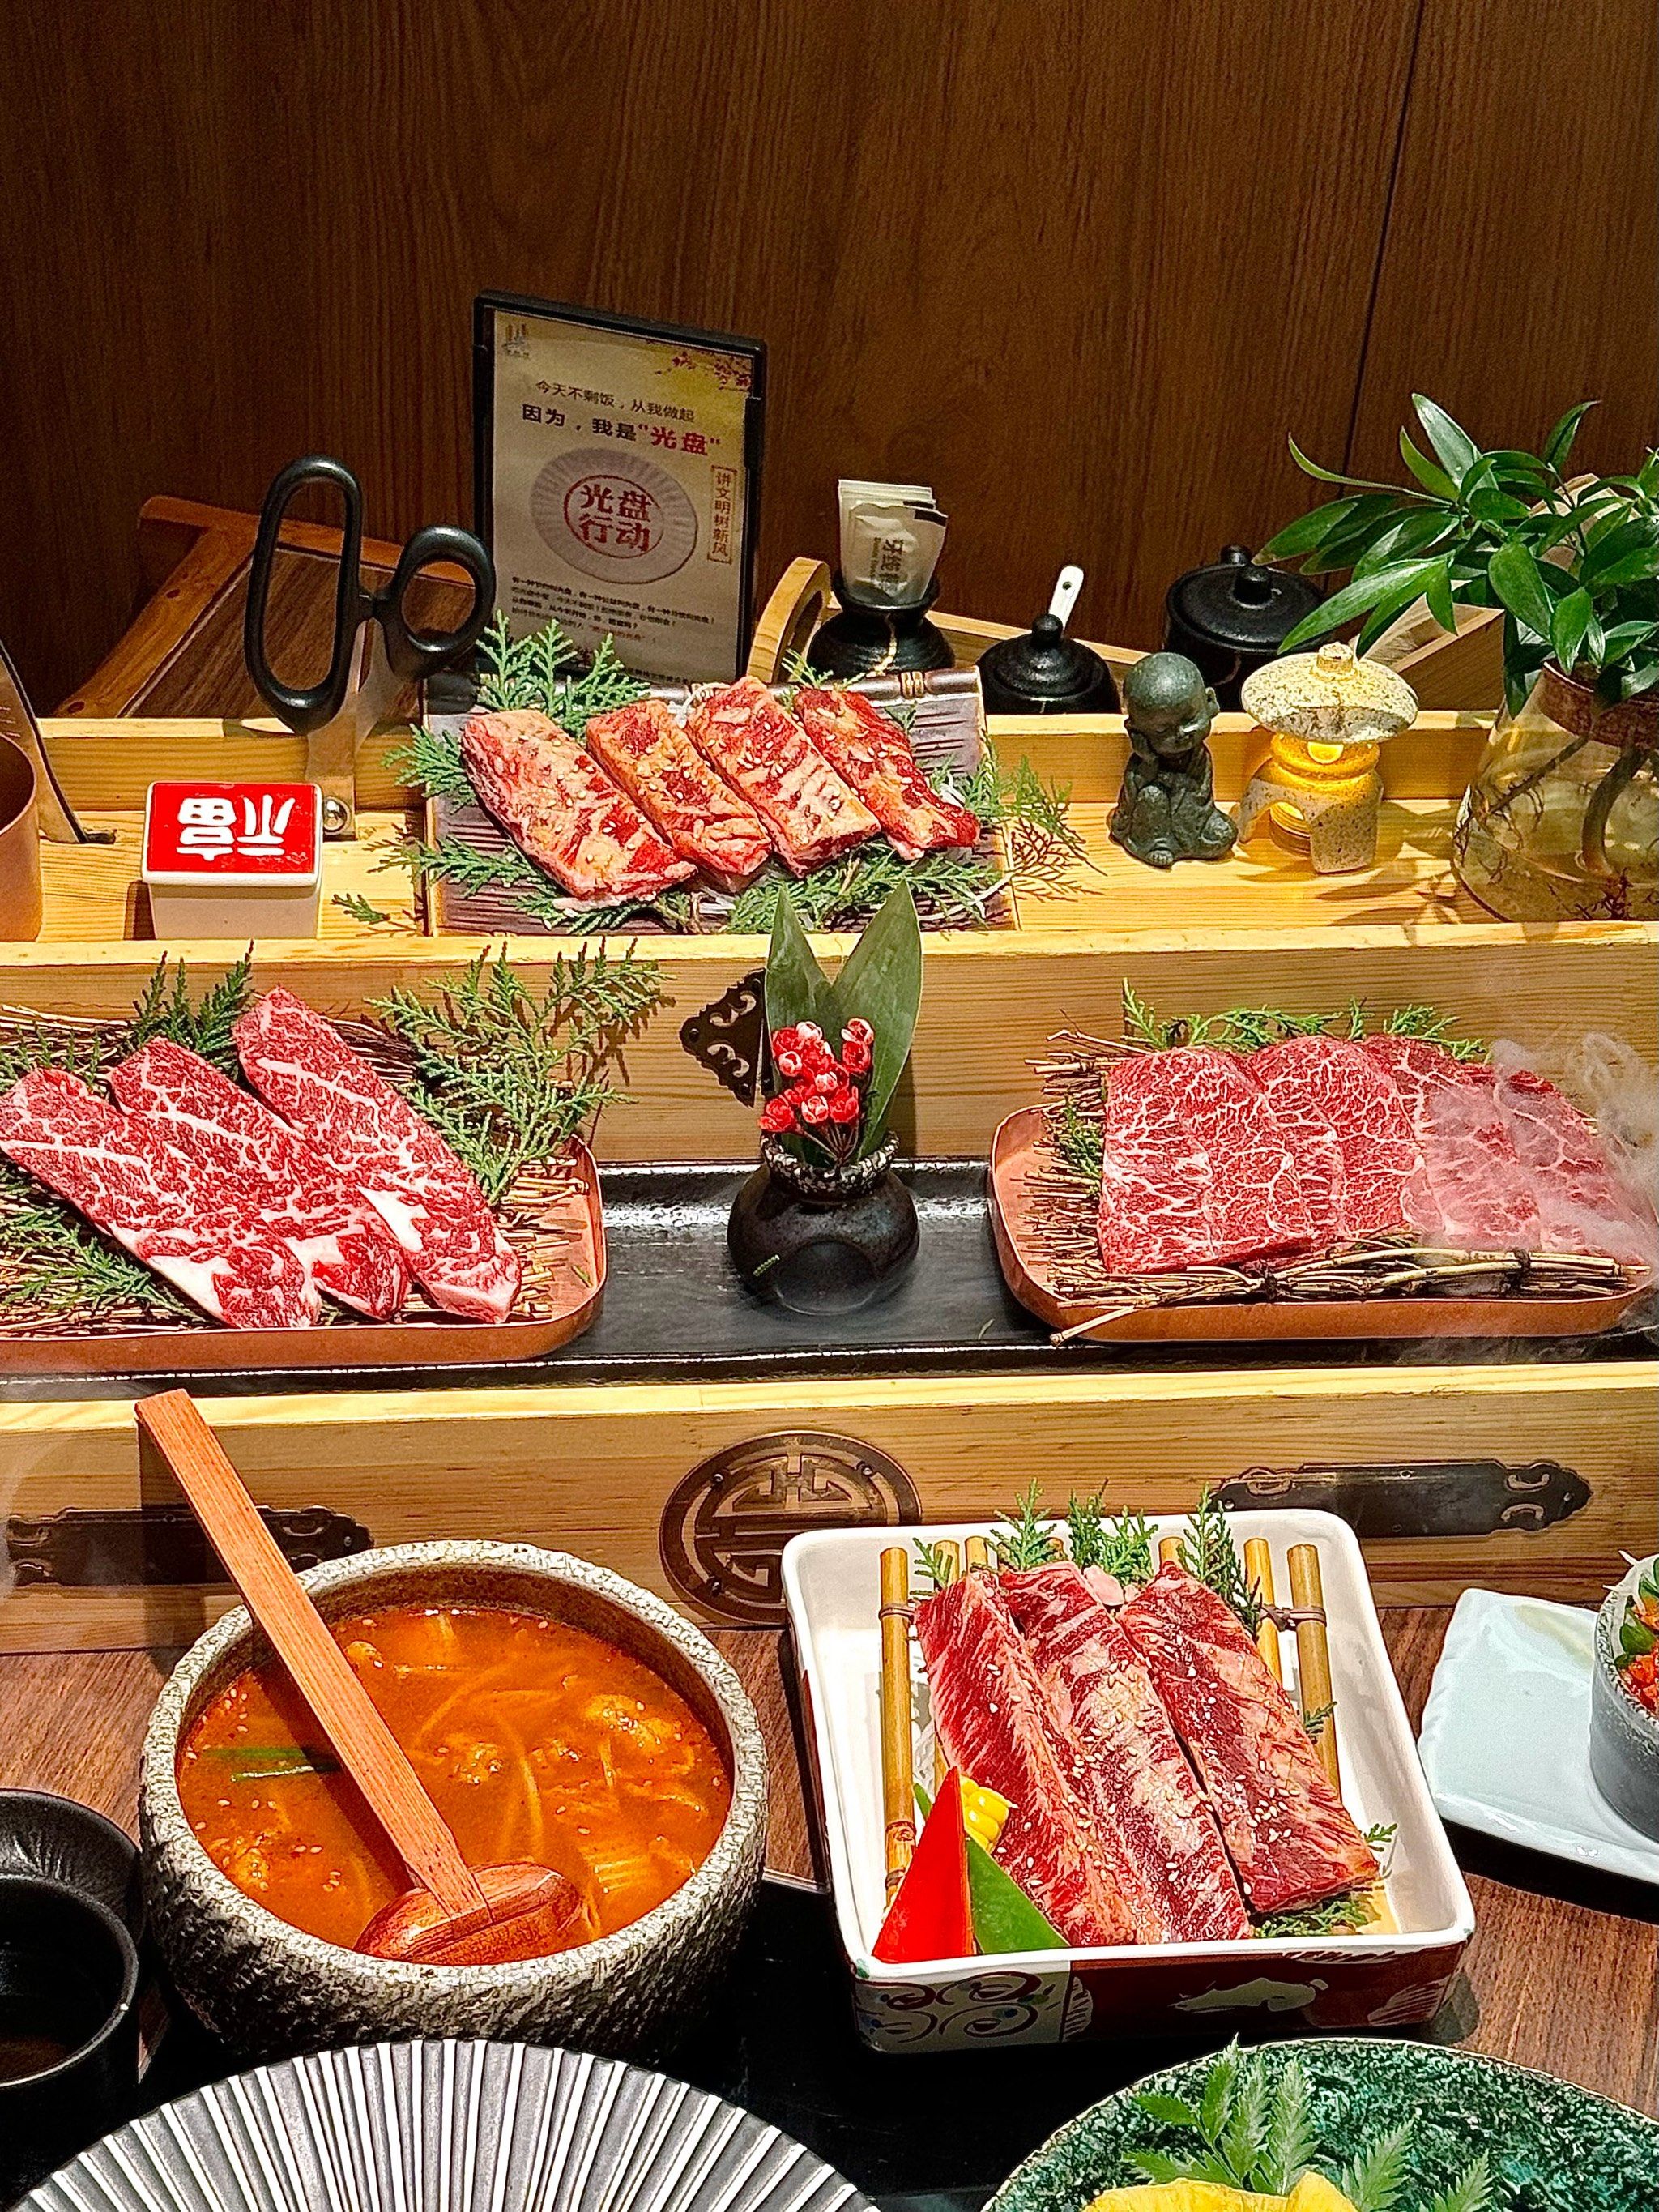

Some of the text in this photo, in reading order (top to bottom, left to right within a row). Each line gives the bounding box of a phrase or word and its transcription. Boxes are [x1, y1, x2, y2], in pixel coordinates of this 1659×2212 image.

[535, 379, 695, 423] 今天不剩饭，从我做起
[580, 484, 651, 523] 光盘
[711, 472, 731, 557] 讲文明树新风
[578, 513, 651, 552] 行动
[176, 793, 296, 861] 福
